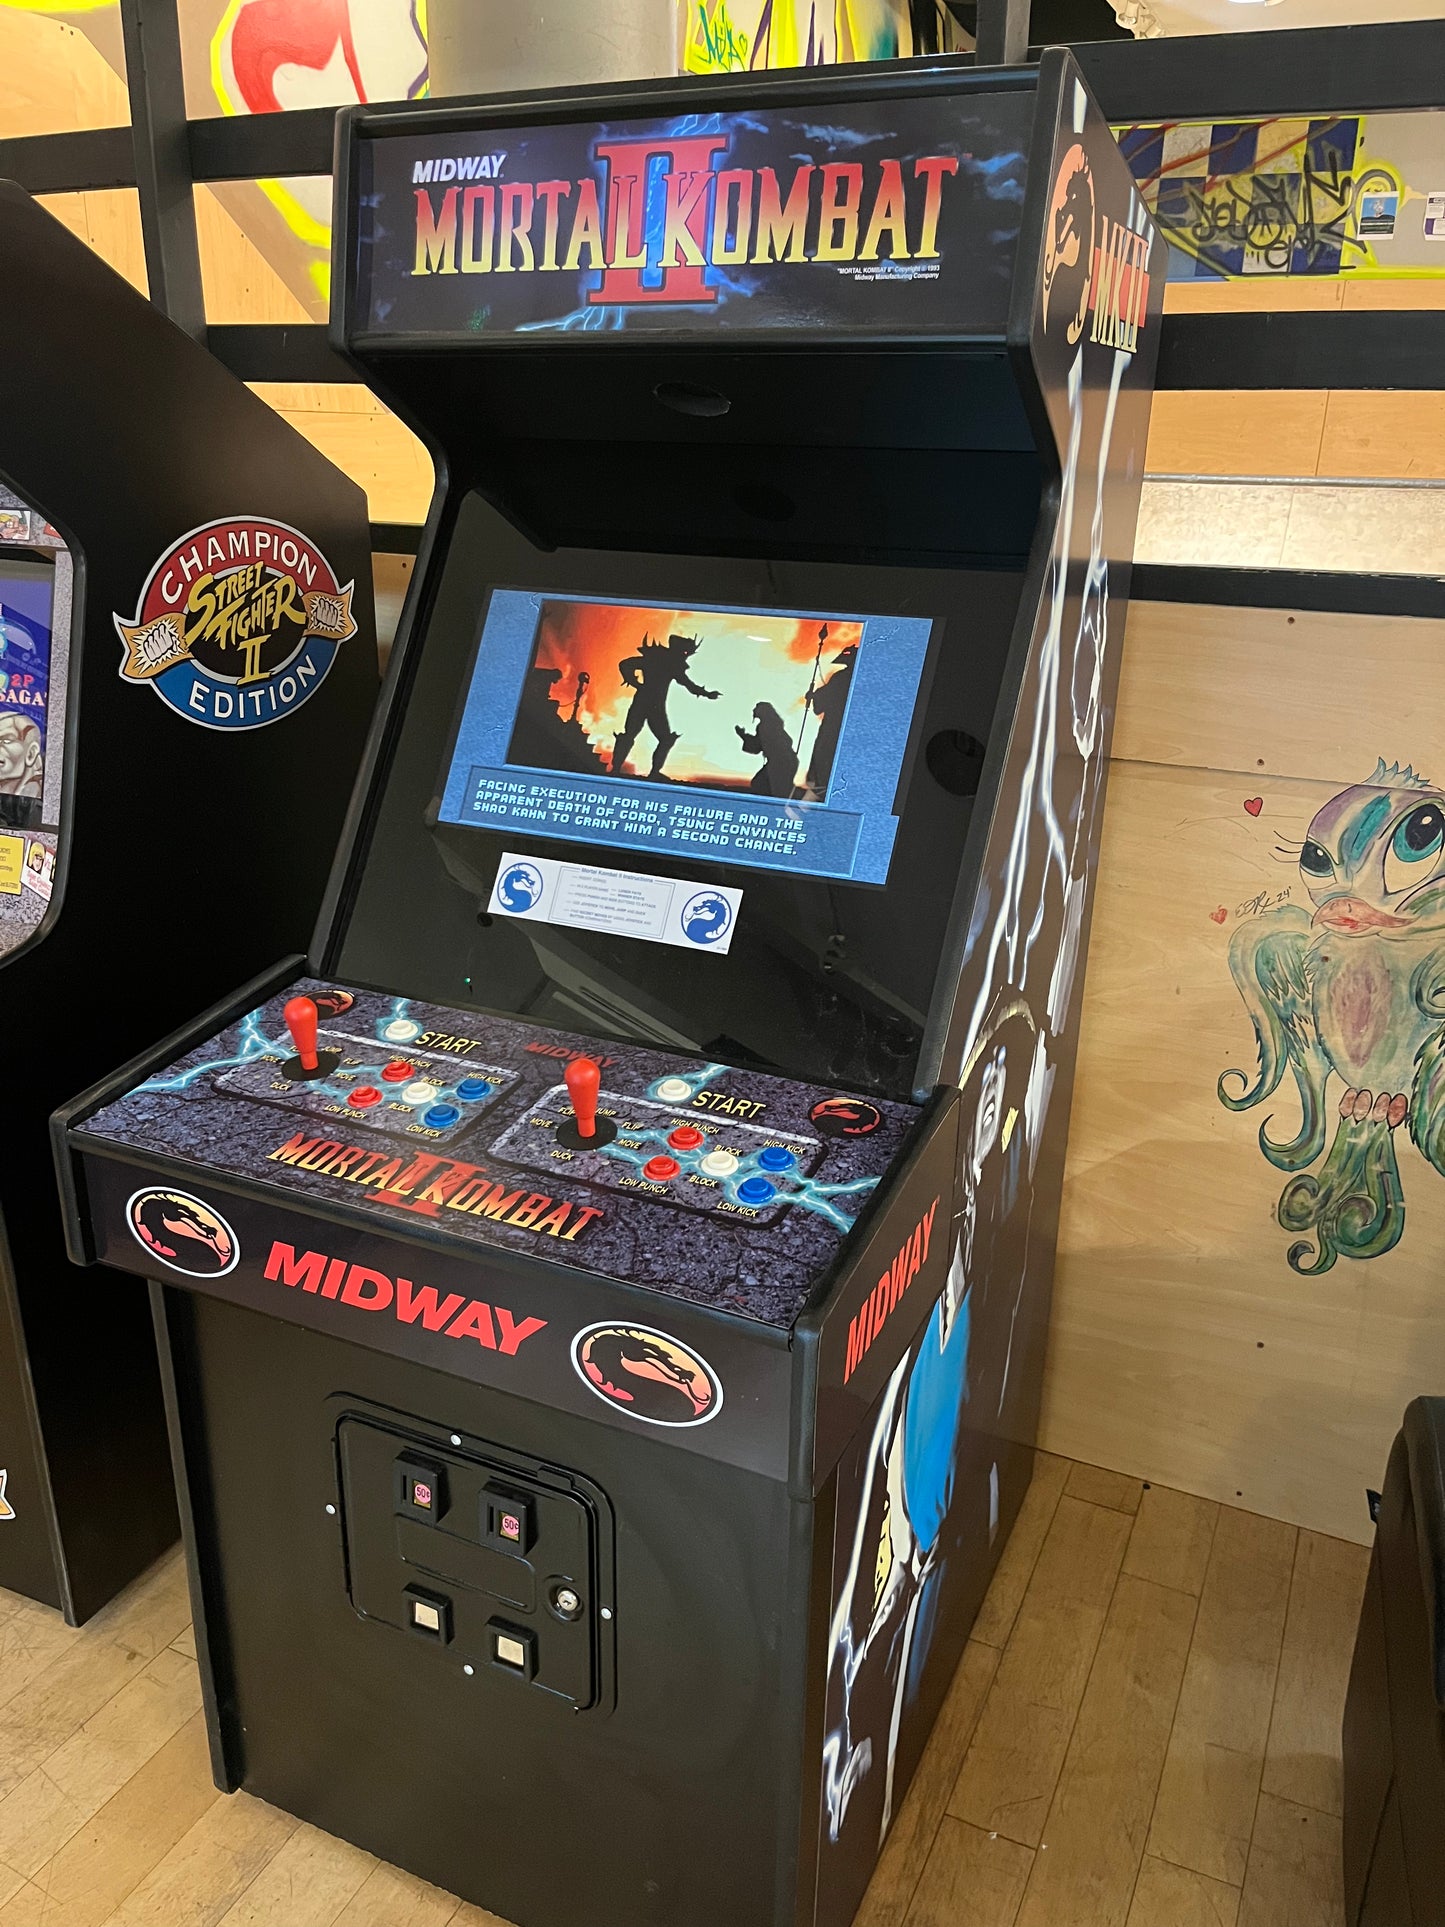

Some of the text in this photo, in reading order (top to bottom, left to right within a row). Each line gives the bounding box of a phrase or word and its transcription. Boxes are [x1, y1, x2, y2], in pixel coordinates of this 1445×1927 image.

[412, 154, 507, 184] MIDWAY
[411, 156, 959, 276] MORTAL KOMBAT
[589, 137, 728, 303] II
[854, 271, 940, 282] Midway Manufacturing Company
[161, 530, 318, 605] CHAMPION
[183, 560, 264, 650] STREET
[202, 574, 307, 650] FIGHTER
[236, 633, 272, 686] II
[10, 673, 35, 688] 2P
[189, 653, 318, 719] EDITION
[478, 779, 804, 831] FACING EXECUTION FOR HIS FAILURE AND THE
[475, 790, 808, 844] APPARENT DEATH OF GORO, TSUNG CONVINCES
[472, 801, 798, 856] SHAO KAHN TO GRANT HIM A SECOND CHANCE.
[414, 1031, 483, 1055] START
[407, 1056, 433, 1069] PUNCH
[523, 1041, 621, 1068] MIDWAY
[421, 1076, 447, 1087] BLOCK
[486, 1075, 504, 1085] KICK
[324, 1103, 367, 1120] LOW PUNCH
[388, 1102, 415, 1113] BLOCK
[691, 1091, 767, 1119] START
[406, 1124, 442, 1138] LOW KICK
[529, 1117, 553, 1129] MOVE
[621, 1121, 644, 1131] FLIP
[670, 1118, 720, 1135] HIGH PUNCH
[617, 1138, 642, 1150] MOVE
[714, 1144, 743, 1158] BLOCK
[763, 1139, 806, 1156] HIGH KICK
[550, 1149, 575, 1161] DUCK
[265, 1132, 604, 1242] MORTAL KOMBAT
[618, 1176, 669, 1196] LOW PUNCH
[688, 1175, 718, 1189] BLOCK
[716, 1201, 759, 1218] LOW KICK
[263, 1240, 549, 1357] MIDWAY
[843, 1194, 941, 1386] MIDWAY
[416, 1486, 431, 1499] 50¢
